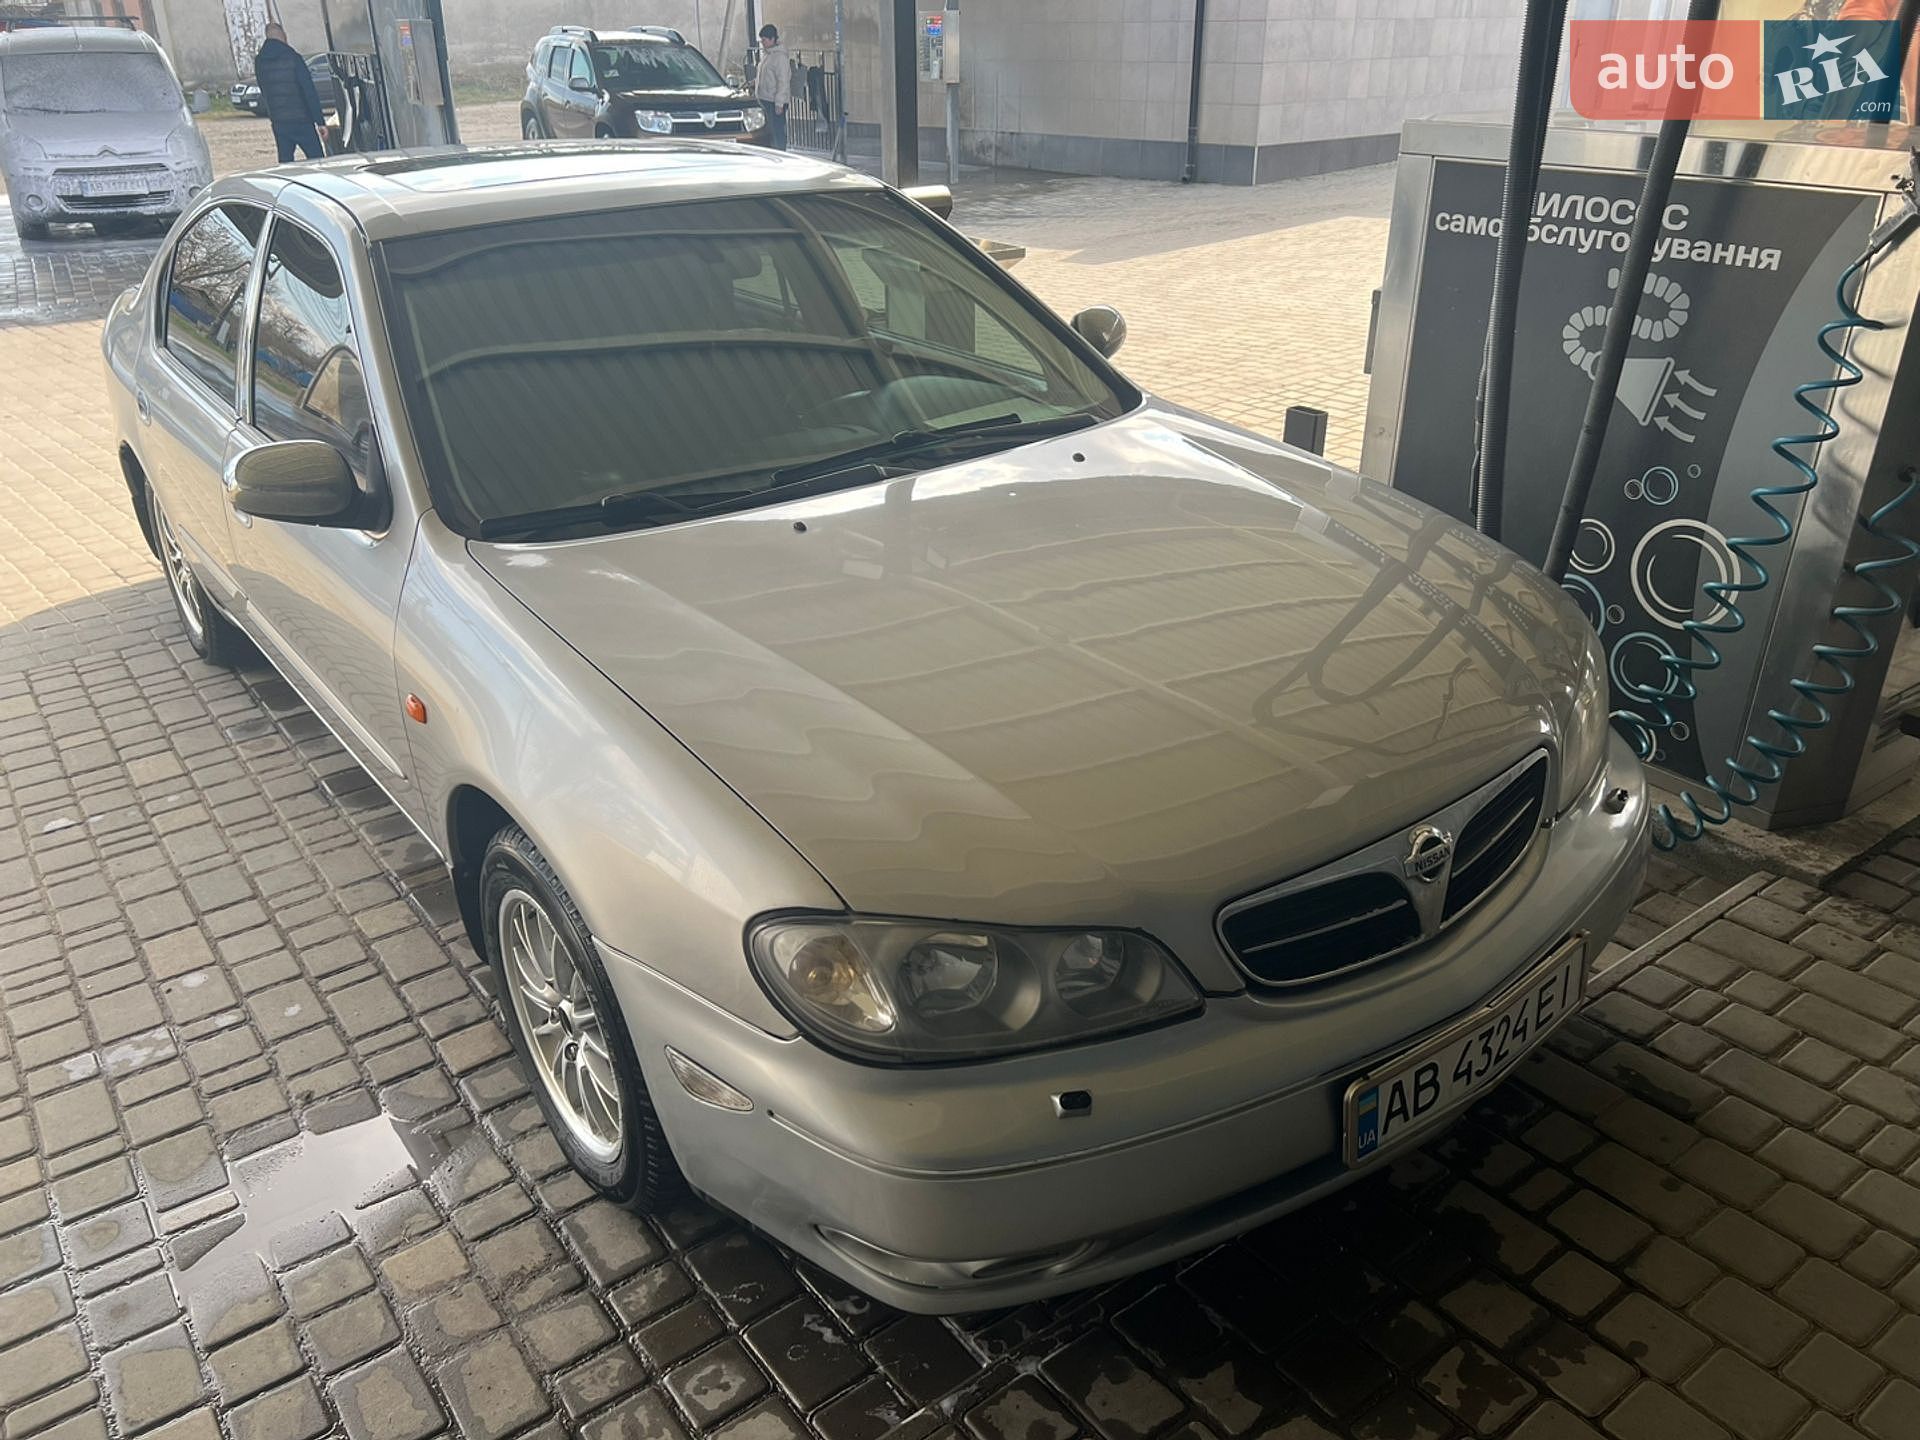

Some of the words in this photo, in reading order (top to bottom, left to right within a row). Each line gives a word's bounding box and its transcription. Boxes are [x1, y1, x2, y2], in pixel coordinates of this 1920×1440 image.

[1532, 191, 1690, 231] ИЛОСС
[1435, 212, 1782, 272] самобслугоування
[1415, 847, 1450, 872] NISSAN
[1382, 1061, 1441, 1136] AB
[1452, 997, 1530, 1087] 4324
[1358, 1132, 1376, 1150] UA
